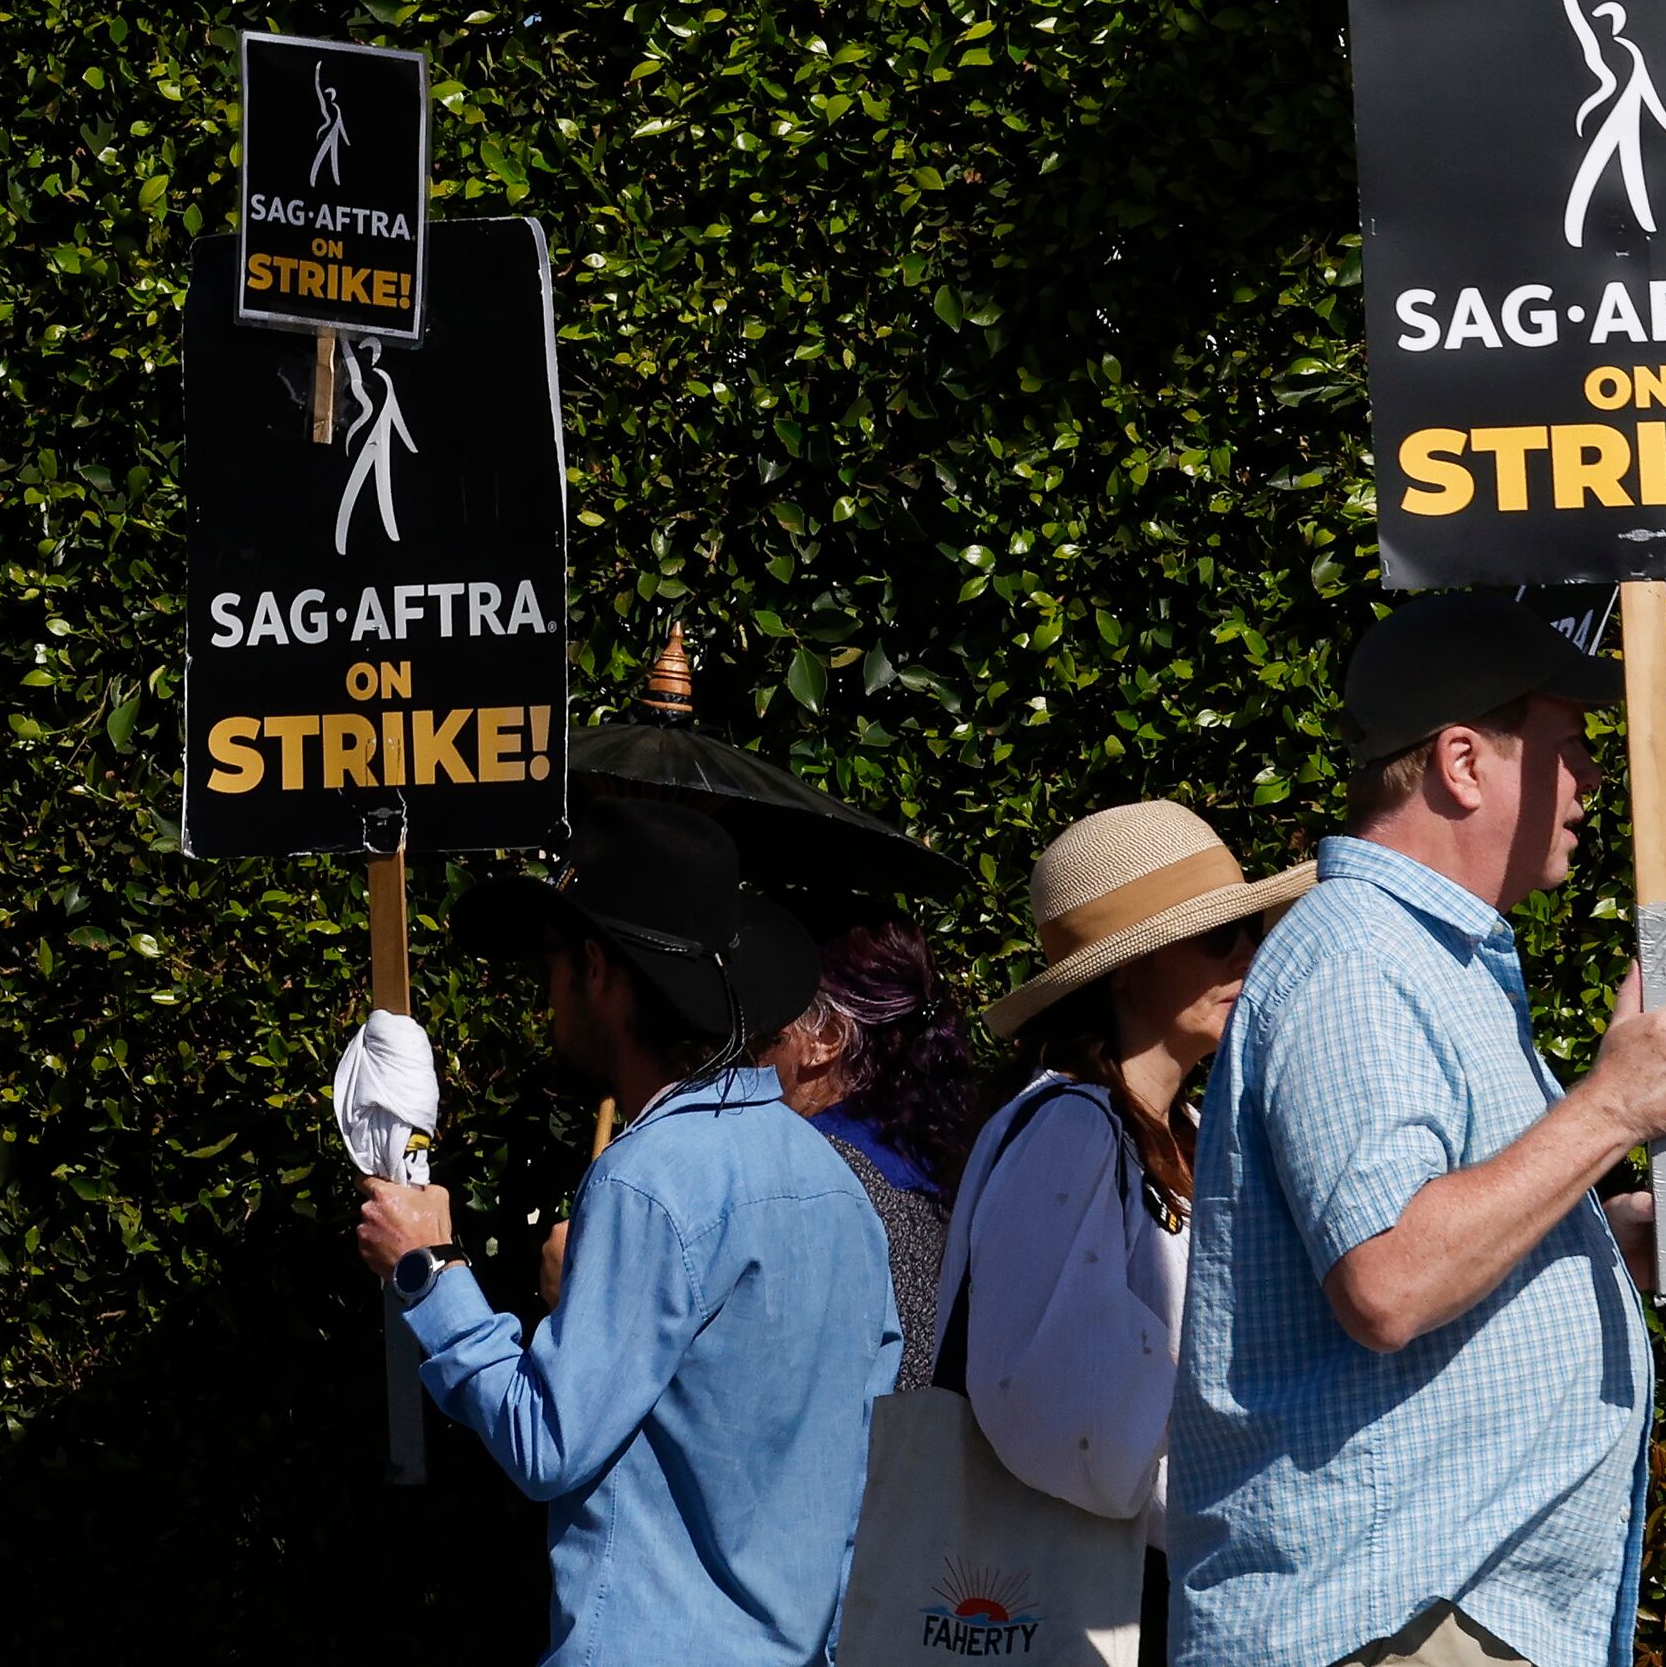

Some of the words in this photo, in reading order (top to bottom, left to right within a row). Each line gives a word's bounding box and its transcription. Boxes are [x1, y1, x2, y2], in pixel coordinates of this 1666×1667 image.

[312, 238, 344, 260] ON
[247, 253, 412, 310] STRIKE!
[346, 661, 412, 701] ON
[206, 705, 551, 795] STRIKE!
[923, 1615, 1039, 1656] FAHERTY
